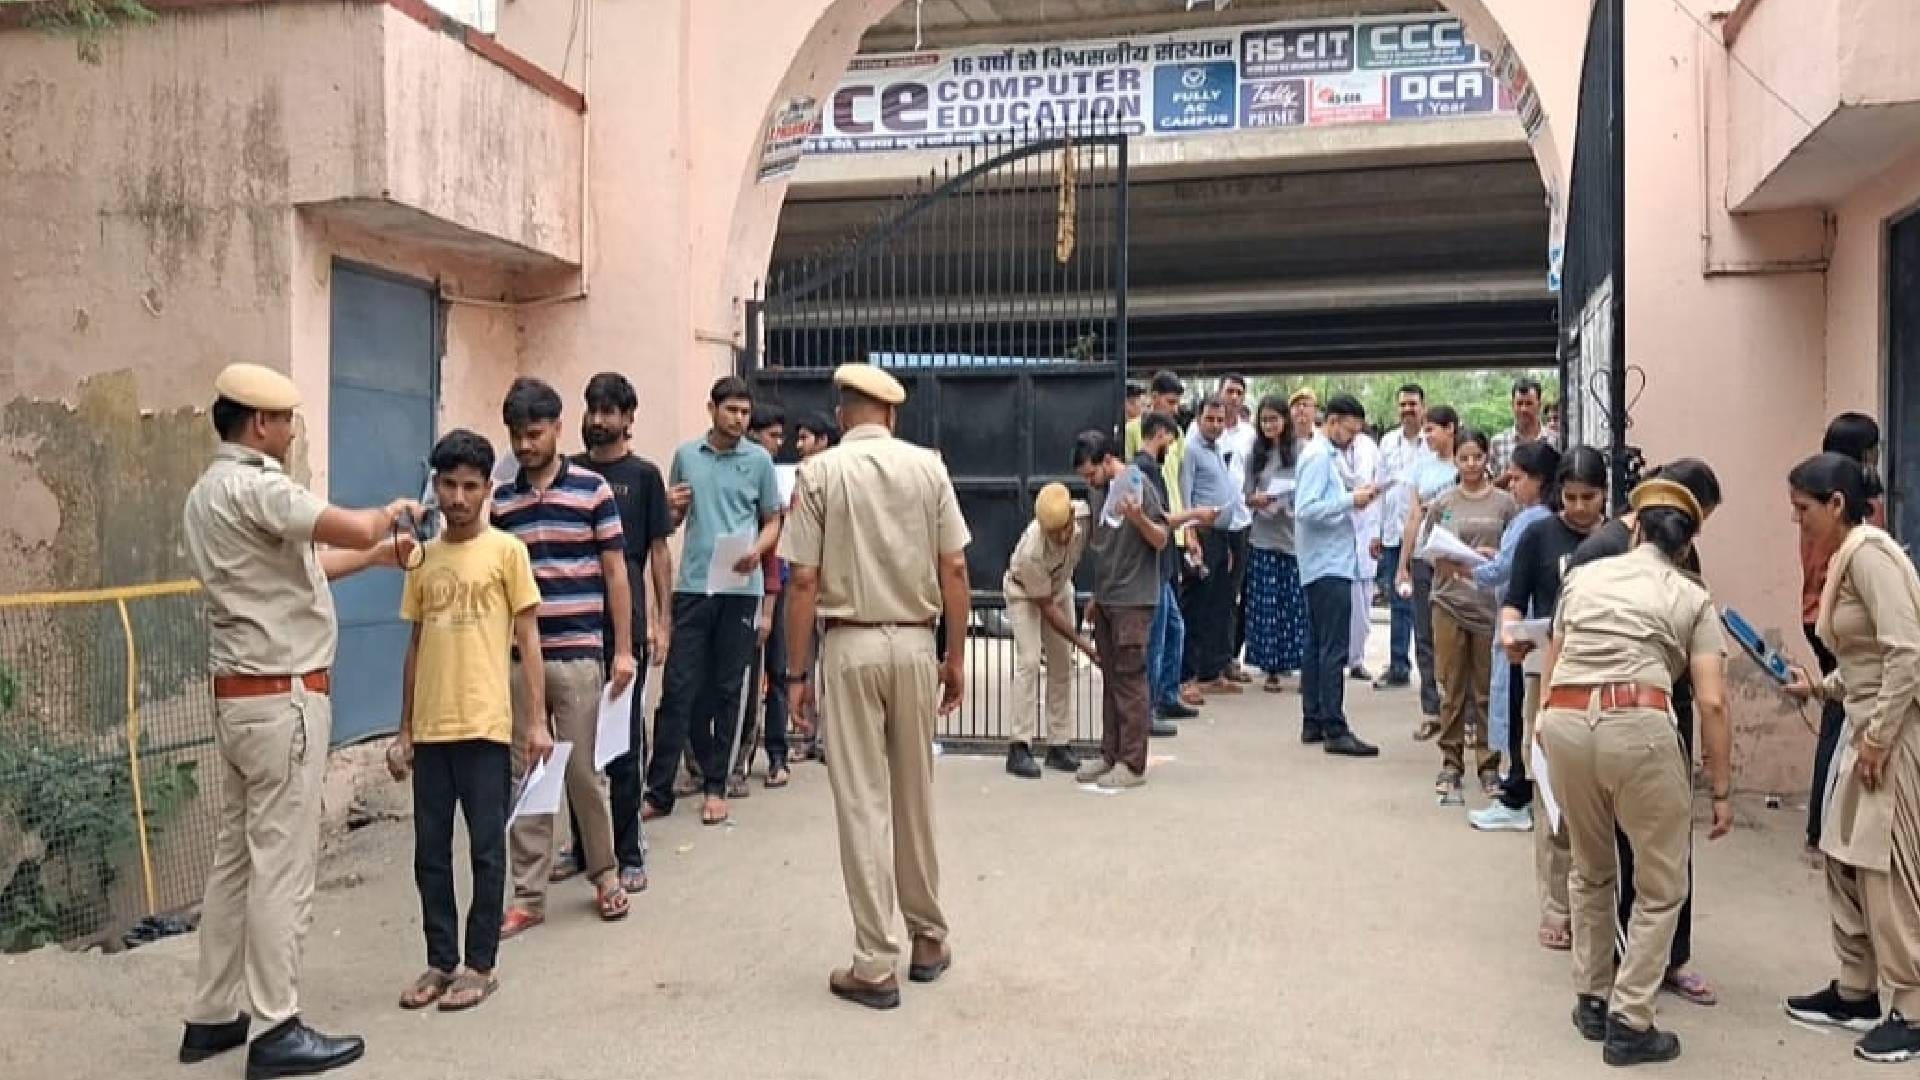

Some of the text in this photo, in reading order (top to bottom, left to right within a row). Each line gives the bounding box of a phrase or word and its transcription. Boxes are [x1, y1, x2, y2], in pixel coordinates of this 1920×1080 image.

[1370, 22, 1461, 51] CCC
[952, 57, 974, 76] 16
[1018, 49, 1037, 71] से
[1042, 41, 1150, 69] विश्वसनीय
[1154, 36, 1232, 62] संस्थान
[938, 67, 1142, 103] COMPUTER
[1172, 89, 1220, 103] FULLY
[1400, 71, 1482, 101] DCA
[938, 95, 1142, 129] EDUCATION
[1160, 112, 1228, 128] CAMPUS
[1248, 109, 1297, 126] PRIME
[1415, 101, 1465, 115] 1 Year
